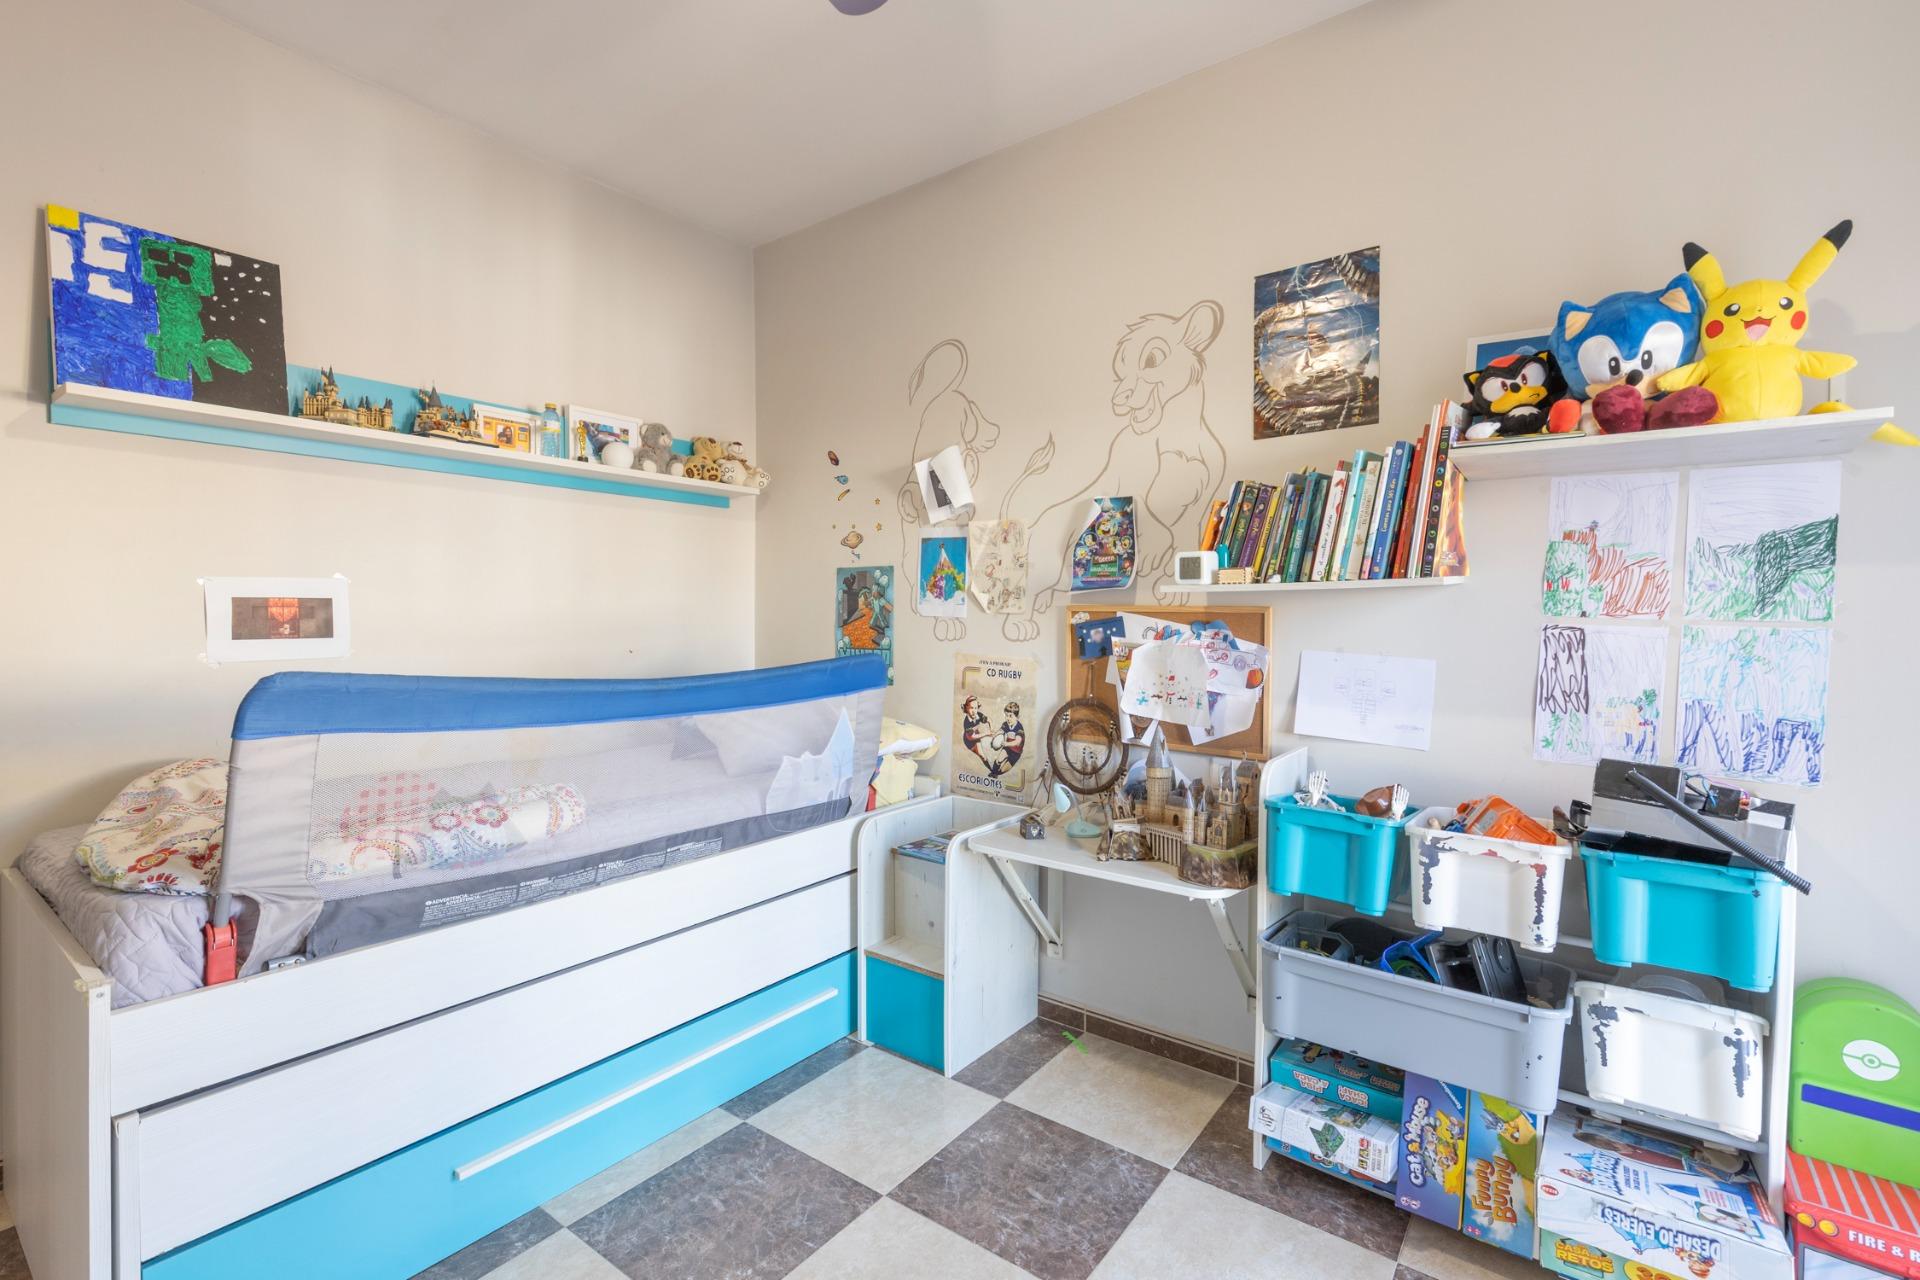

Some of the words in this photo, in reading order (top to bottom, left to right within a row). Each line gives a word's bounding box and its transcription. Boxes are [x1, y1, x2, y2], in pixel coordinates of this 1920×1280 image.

[986, 668, 996, 678] CD
[998, 668, 1022, 680] RUGBY
[958, 773, 1003, 789] ESCORIONES
[1293, 1070, 1320, 1085] CACA
[1300, 1080, 1324, 1093] PISA
[1403, 1097, 1429, 1142] Mouse
[1472, 1157, 1495, 1211] Funny
[1493, 1155, 1517, 1224] Bunny
[1555, 1241, 1590, 1257] CASA
[1848, 1230, 1887, 1252] FIRE
[1891, 1245, 1904, 1258] &
[1556, 1249, 1614, 1273] RETOS
